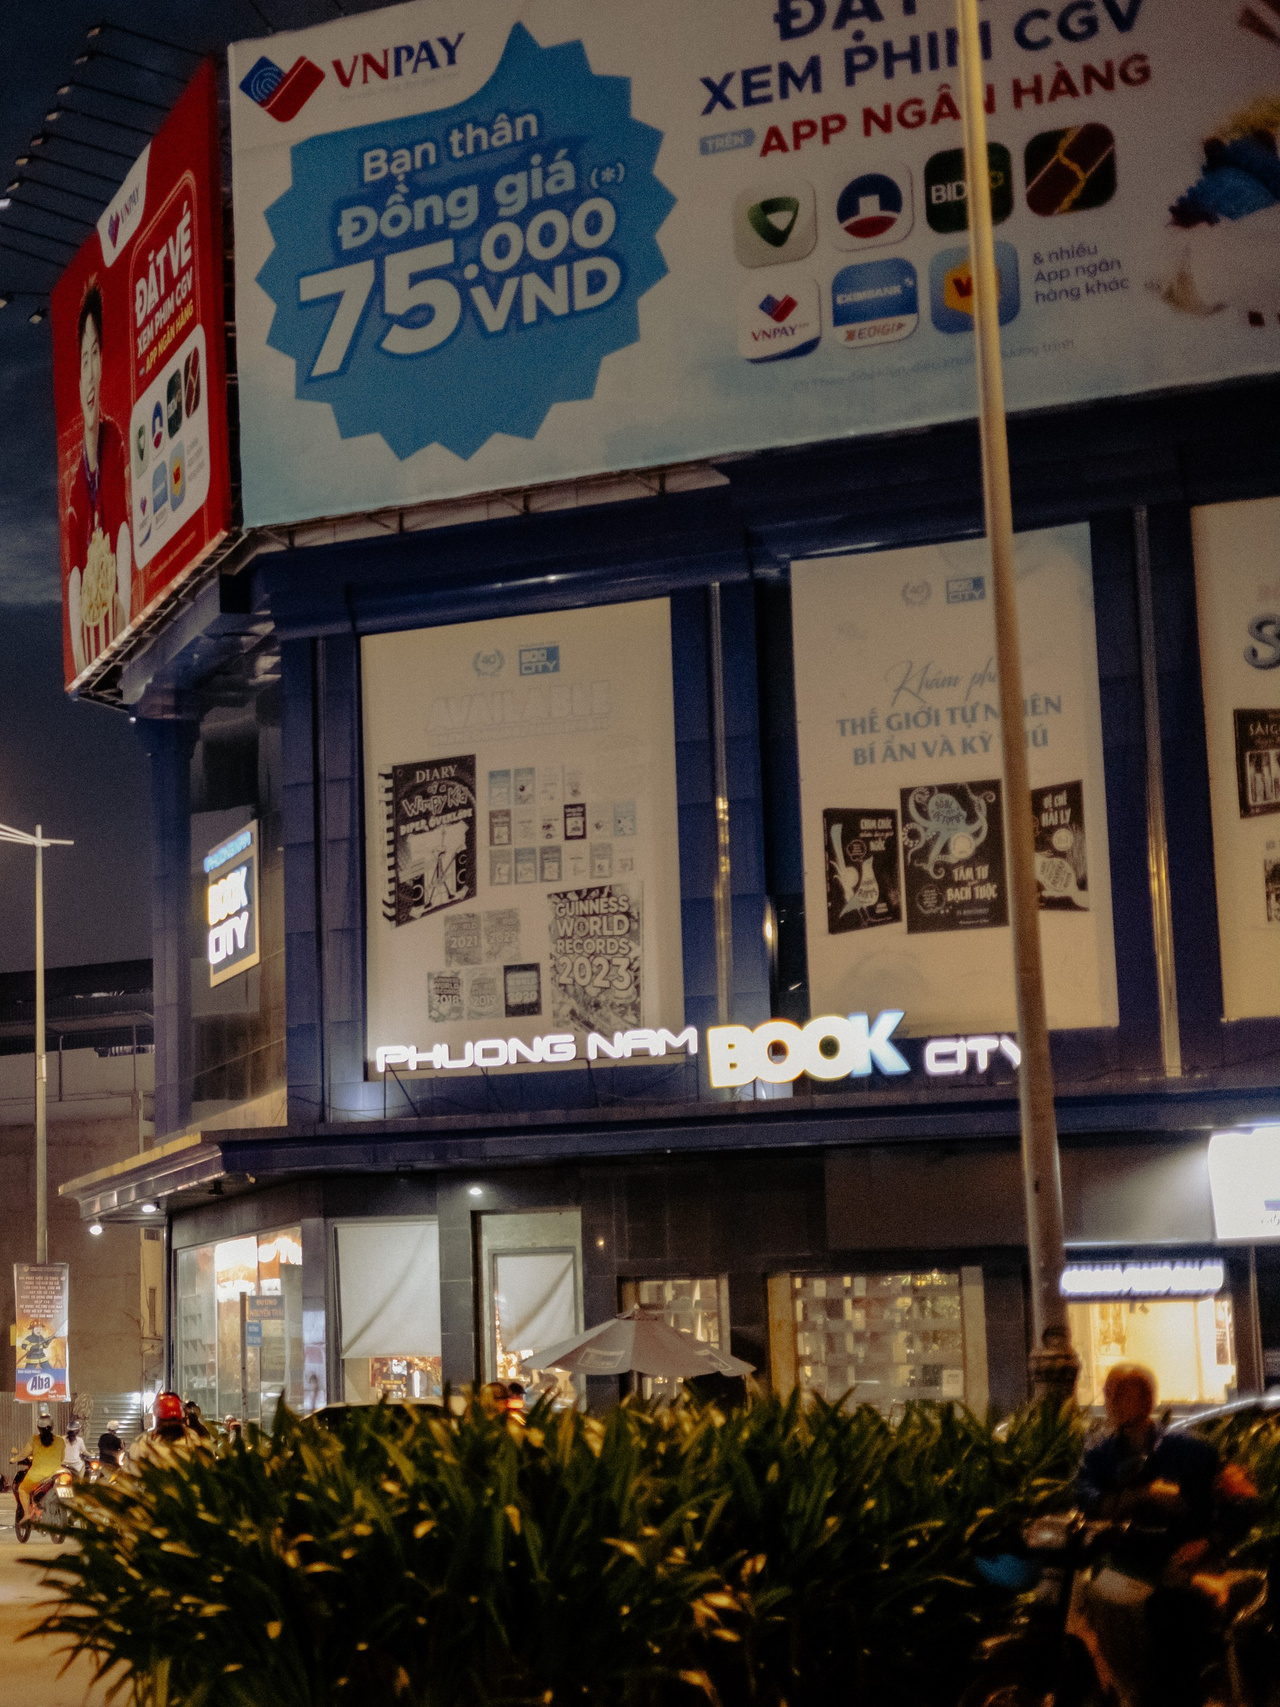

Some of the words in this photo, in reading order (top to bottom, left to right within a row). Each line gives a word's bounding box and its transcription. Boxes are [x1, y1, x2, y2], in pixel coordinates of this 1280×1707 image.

[332, 32, 466, 88] VNPAY
[700, 55, 822, 116] XEM
[1014, 0, 1143, 50] CGV
[759, 113, 848, 157] APP
[1012, 53, 1152, 110] HÀNG
[363, 139, 437, 183] Bạn
[448, 113, 539, 161] thân
[338, 176, 479, 251] Đồng
[494, 149, 576, 216] giá
[930, 180, 967, 206] BID
[471, 256, 622, 334] VND
[751, 325, 798, 343] VNPAY
[837, 705, 880, 737] THẾ
[886, 704, 940, 732] GIỚI
[946, 701, 980, 729] TỰ
[984, 692, 1062, 722] NIÊN
[853, 741, 876, 766] BÍ
[921, 733, 956, 759] VÀ
[415, 764, 458, 784] DIARY
[556, 895, 630, 918] GUINNESS
[557, 914, 630, 938] WORLD
[208, 911, 249, 965] CITY
[450, 935, 478, 949] 2021
[557, 938, 630, 955] RECORDS
[559, 956, 632, 991] 2023
[375, 1033, 577, 1073] PHUONG
[587, 1026, 699, 1060] NAM
[706, 1009, 912, 1089] BOOK
[924, 1035, 1021, 1077] CITY
[30, 1375, 52, 1392] Aba
